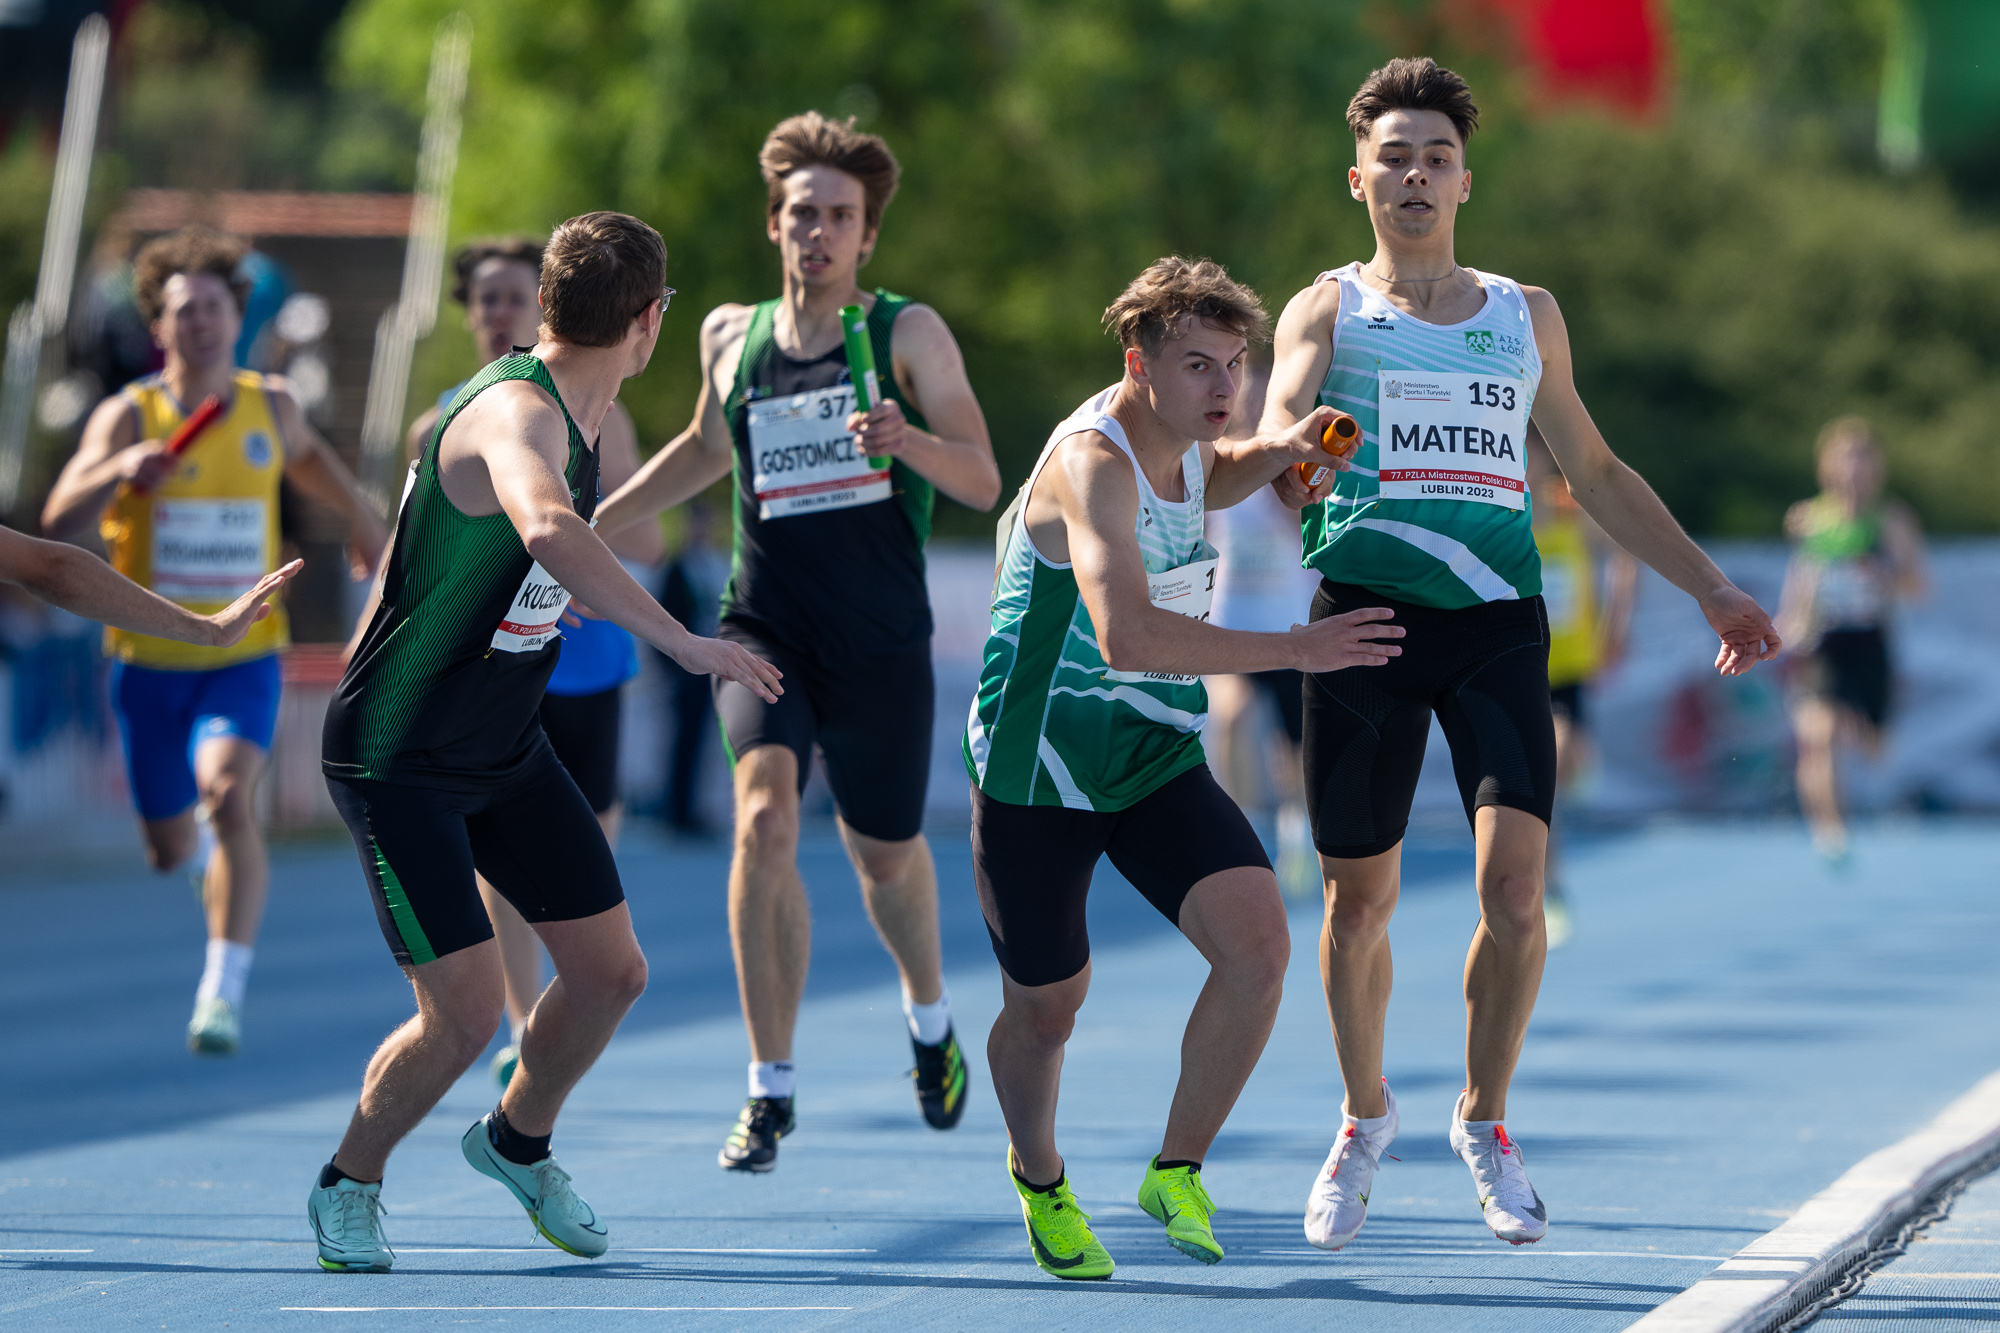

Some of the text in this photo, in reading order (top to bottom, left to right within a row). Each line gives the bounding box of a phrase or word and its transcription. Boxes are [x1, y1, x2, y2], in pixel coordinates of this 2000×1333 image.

[1499, 334, 1520, 346] AZS
[1468, 381, 1516, 411] 153
[1391, 424, 1516, 463] MATERA
[1390, 471, 1517, 489] 77. PZLA Mistrzostwa Polski U20
[1421, 484, 1494, 498] LUBLIN 2023
[1143, 671, 1184, 681] LUBLIN
